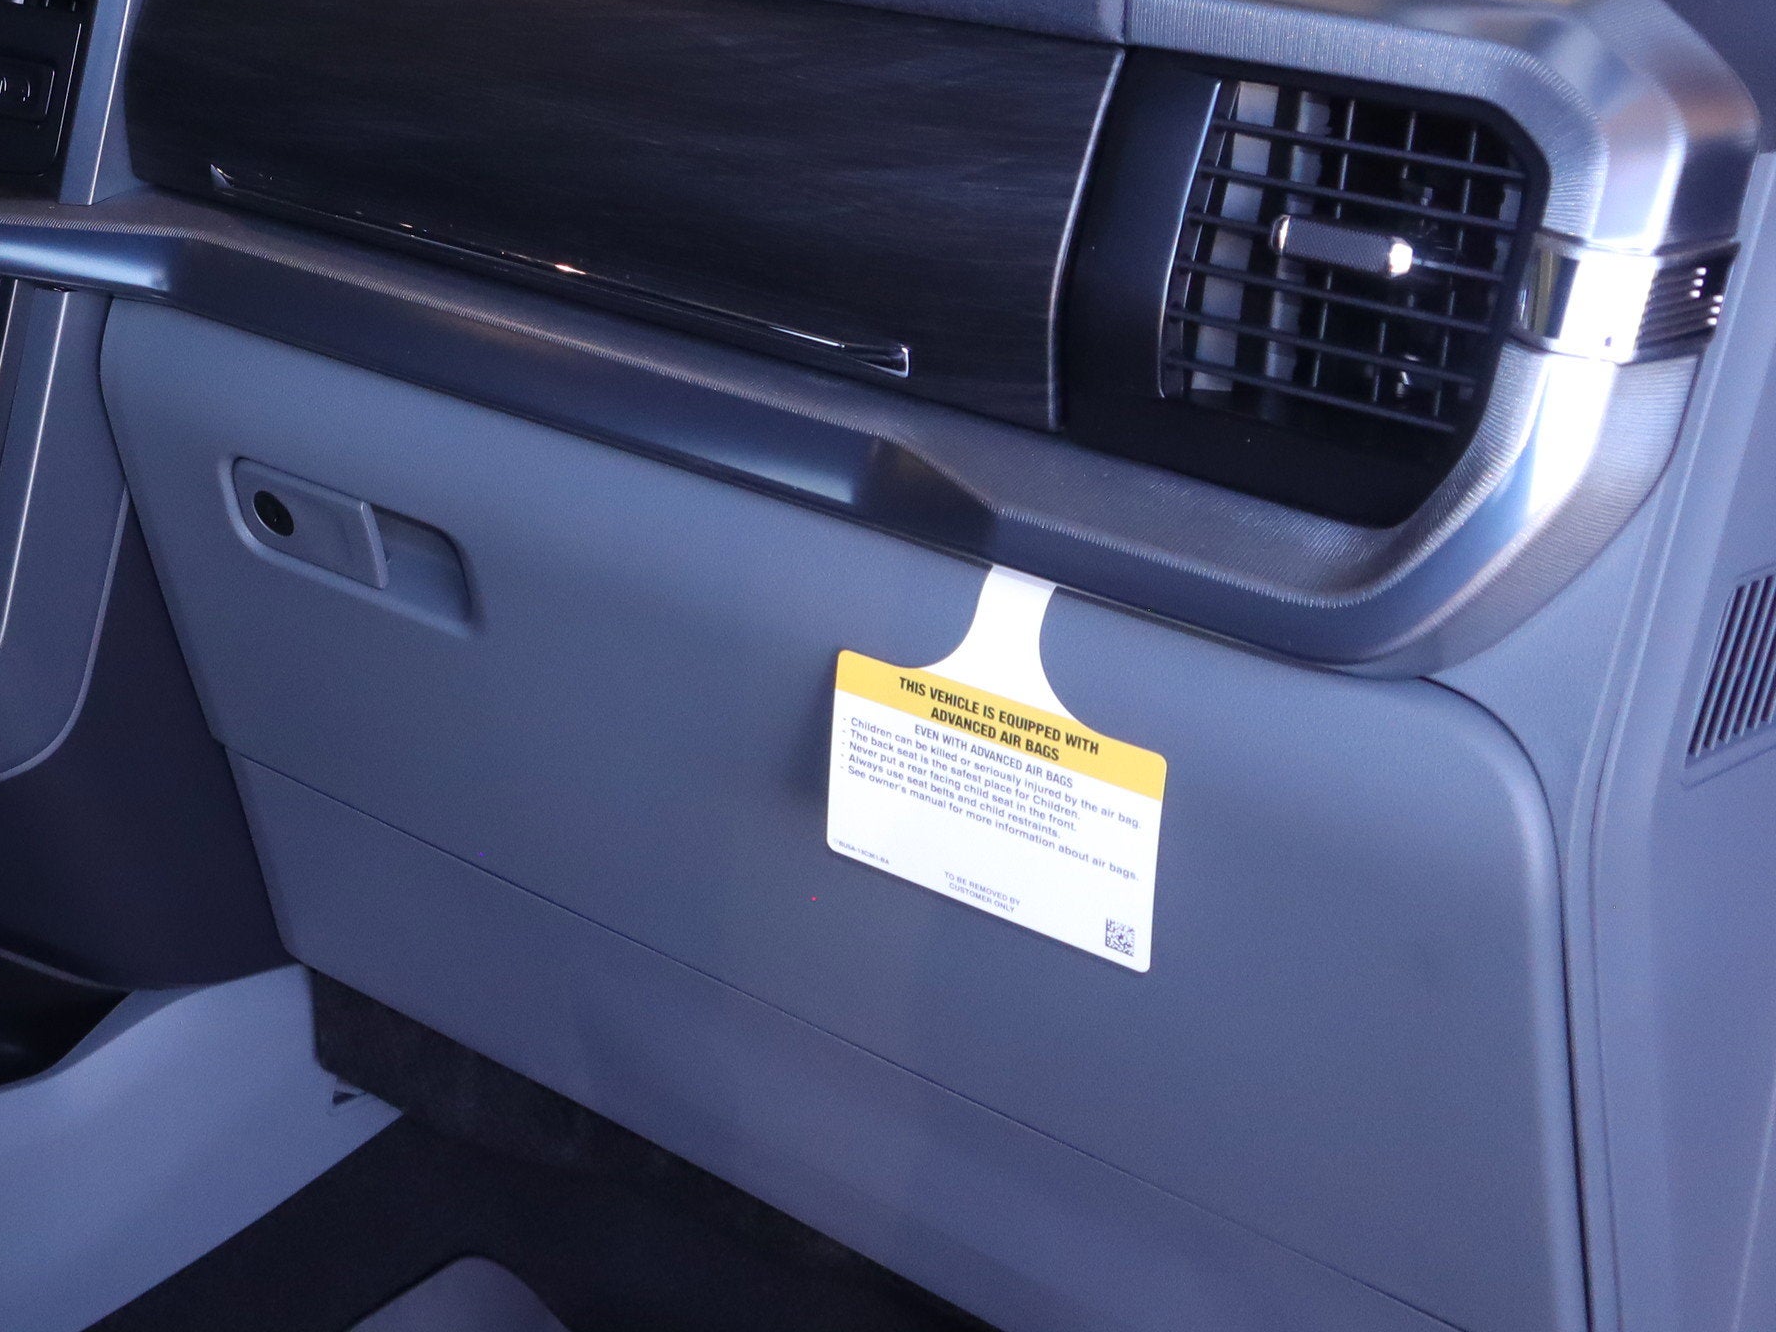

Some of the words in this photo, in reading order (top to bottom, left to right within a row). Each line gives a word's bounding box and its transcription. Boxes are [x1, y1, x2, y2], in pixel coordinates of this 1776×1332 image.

[899, 676, 926, 696] THIS
[930, 686, 979, 714] VEHICLE
[983, 705, 995, 720] IS
[999, 710, 1061, 741] EQUIPPED
[1065, 732, 1099, 755] WITH
[930, 707, 997, 739] ADVANCED
[999, 731, 1021, 749] AIR
[1025, 739, 1059, 761] BAGS
[849, 741, 877, 757] Never
[880, 753, 896, 765] put
[907, 764, 927, 776] rear
[930, 770, 961, 790] facing
[964, 784, 989, 799] child
[992, 794, 1014, 808] seat
[1017, 801, 1026, 812] in
[1029, 806, 1046, 820] the
[850, 717, 892, 739] Children
[895, 734, 912, 746] can
[915, 740, 928, 751] be
[930, 745, 957, 763] killed
[960, 758, 971, 767] or
[974, 762, 1021, 787] seriously
[1025, 778, 1061, 799] injured
[1064, 792, 1078, 807] by
[1081, 799, 1098, 812] the
[1101, 808, 1114, 819] air
[1118, 812, 1141, 829] bag.
[850, 728, 868, 743] The
[871, 737, 894, 752] back
[897, 747, 918, 761] seat
[920, 755, 929, 765] is
[932, 758, 948, 771] the
[950, 766, 982, 783] safest
[984, 778, 1012, 795] place
[1015, 788, 1029, 800] for
[1033, 794, 1080, 820] Children.
[914, 724, 939, 741] EVEN
[942, 734, 968, 751] WITH
[970, 744, 1022, 770] ADVANCED
[1025, 764, 1043, 778] AIR
[1046, 770, 1073, 788] BAGS
[848, 765, 866, 779] See
[868, 774, 907, 794] owner's
[910, 789, 946, 808] manual
[949, 802, 963, 814] for
[966, 810, 992, 826] more
[995, 819, 1055, 849] information
[1058, 845, 1089, 863] about
[1092, 857, 1106, 868] air
[1109, 862, 1139, 882] bags.
[849, 754, 884, 773] Always
[886, 768, 904, 780] use
[907, 776, 928, 789] seat
[930, 783, 955, 799] belts
[957, 795, 977, 807] and
[980, 803, 1005, 818] child
[1008, 813, 1061, 839] restraints.
[944, 871, 955, 881] TO
[957, 876, 967, 886] BE
[969, 881, 1008, 901] REMOVED
[1009, 897, 1020, 907] BY
[949, 882, 993, 904] CUSTOMER
[994, 900, 1015, 913] ONLY
